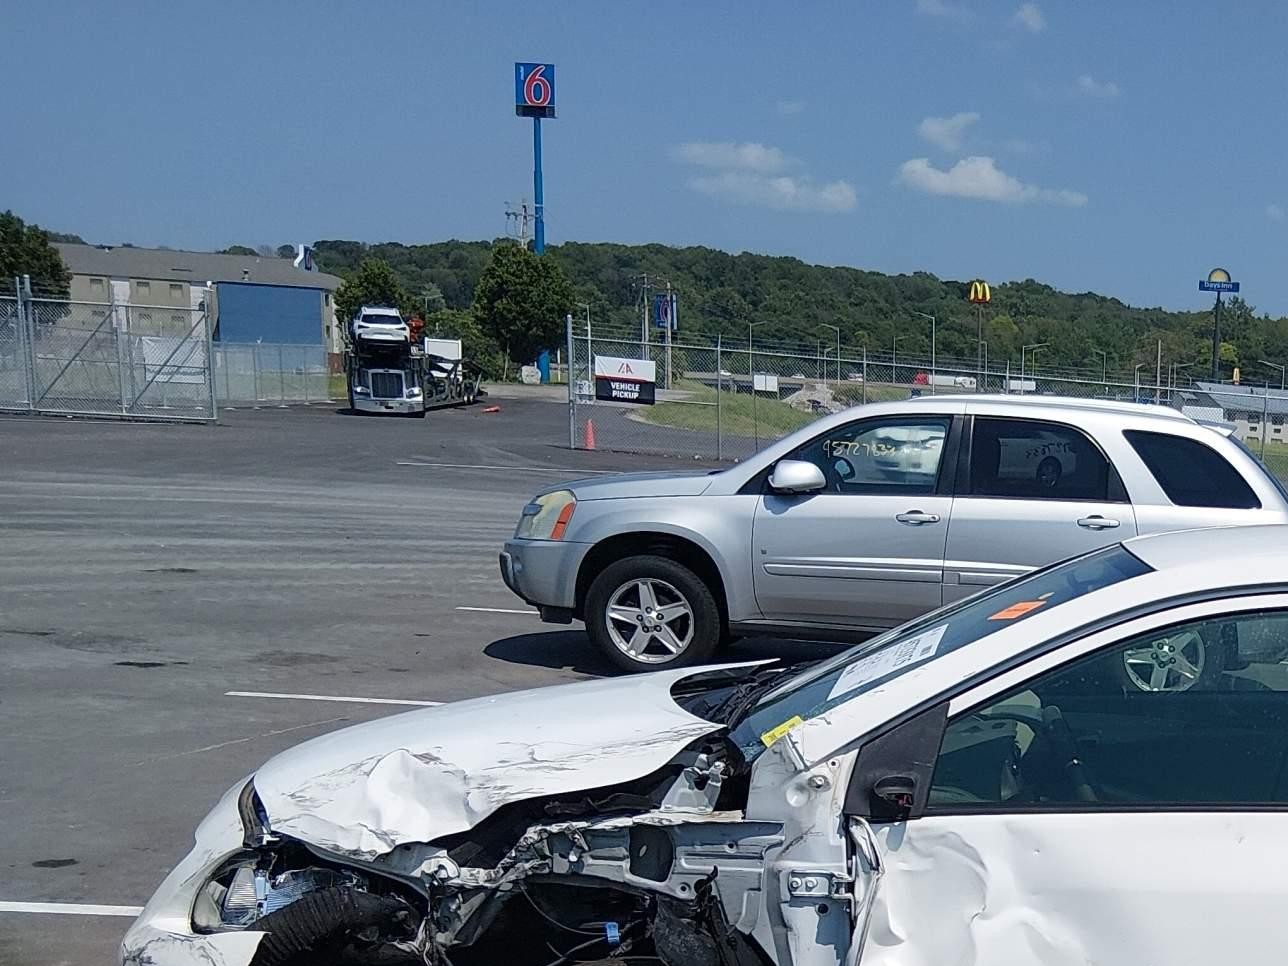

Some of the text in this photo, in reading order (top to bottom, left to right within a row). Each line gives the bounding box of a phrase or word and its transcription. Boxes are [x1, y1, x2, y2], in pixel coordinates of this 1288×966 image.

[524, 65, 551, 106] 6
[1204, 281, 1220, 289] Days
[610, 382, 641, 392] VEHICLE
[612, 390, 640, 399] PICKUP
